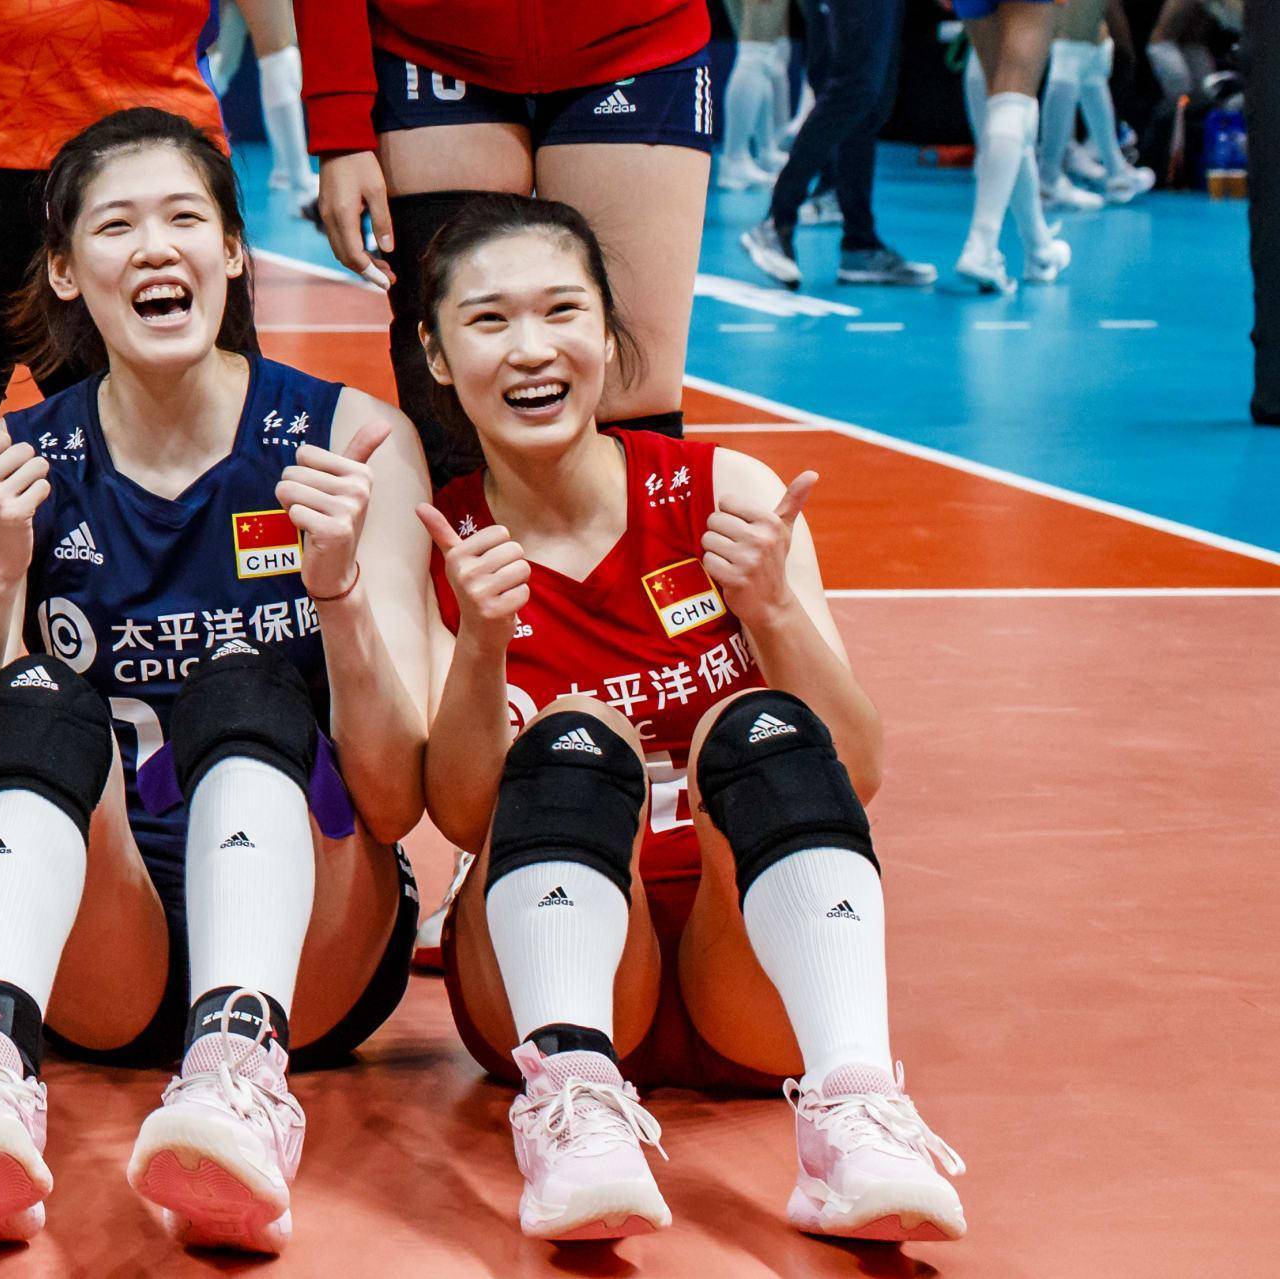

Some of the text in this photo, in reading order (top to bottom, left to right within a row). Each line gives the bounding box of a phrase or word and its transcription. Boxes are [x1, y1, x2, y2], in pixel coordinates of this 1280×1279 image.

[593, 101, 637, 114] adidas
[262, 409, 310, 434] 红旗
[38, 426, 86, 451] 红旗
[645, 464, 692, 494] 红旗
[458, 513, 480, 537] 旗
[54, 544, 104, 566] adidas
[246, 551, 296, 571] CHN
[670, 598, 717, 627] CHN
[111, 598, 321, 652] 太平洋保险
[211, 644, 260, 661] adidas
[9, 677, 60, 691] adidas
[748, 724, 797, 743] adidas
[551, 739, 602, 756] adidas
[219, 840, 256, 850] adidas
[537, 896, 575, 908] adidas
[826, 909, 861, 922] adidas
